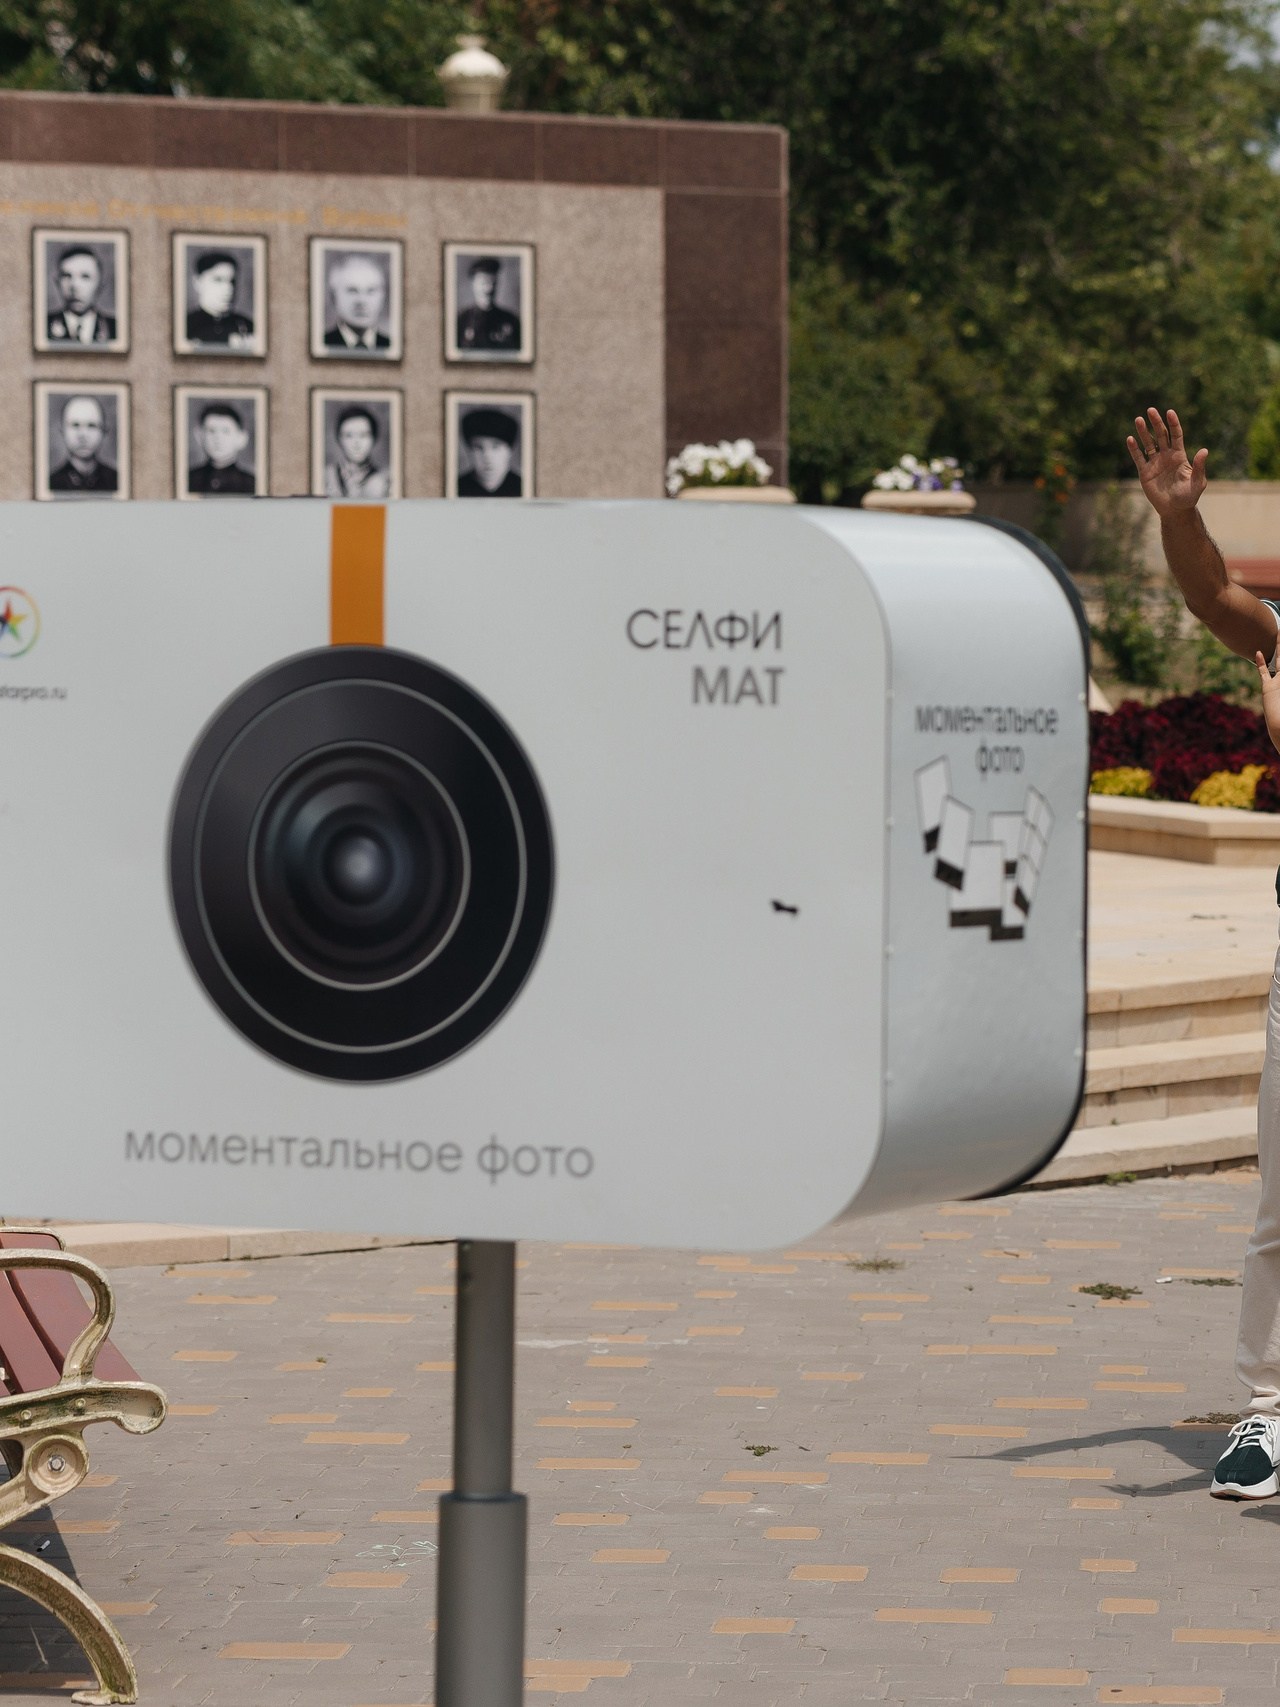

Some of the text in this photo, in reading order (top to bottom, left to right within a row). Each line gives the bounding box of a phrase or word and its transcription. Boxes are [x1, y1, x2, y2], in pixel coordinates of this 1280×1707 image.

[627, 609, 782, 650] СЕЛФИ
[692, 665, 785, 705] МАТ
[915, 705, 1060, 735] моментальное
[975, 738, 1026, 782] фото
[124, 1130, 595, 1185] моментальное фото
